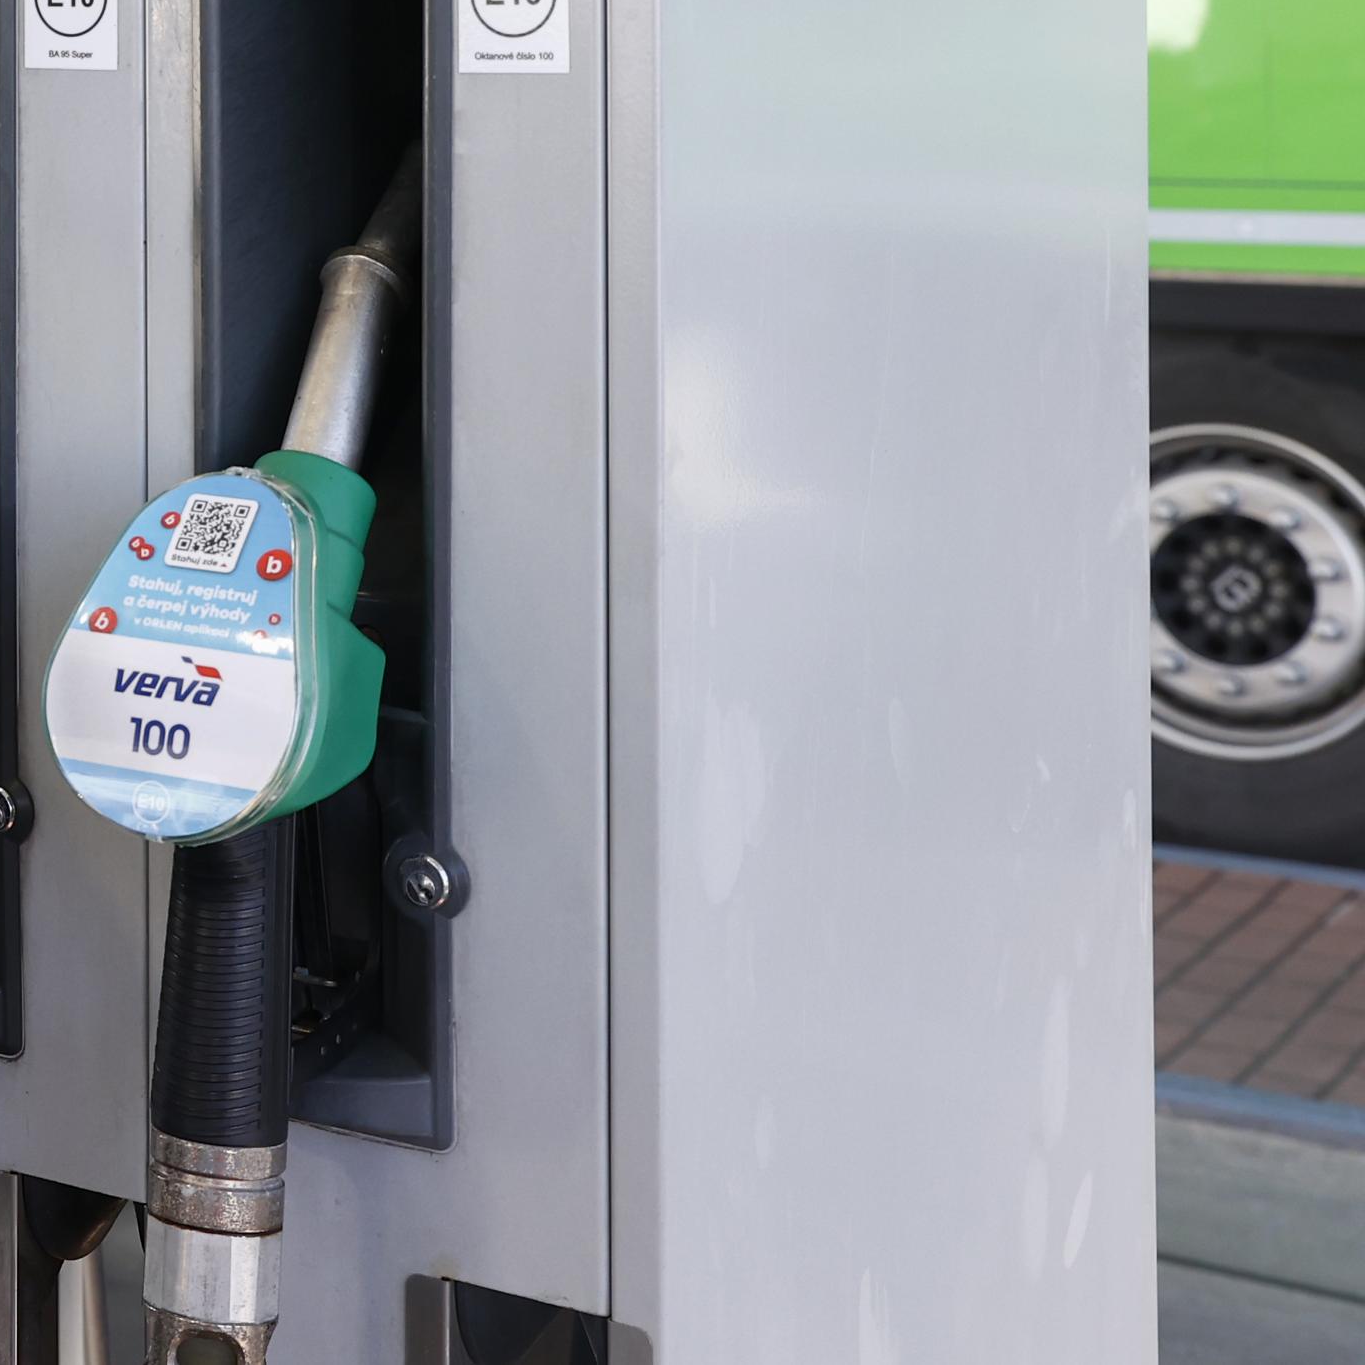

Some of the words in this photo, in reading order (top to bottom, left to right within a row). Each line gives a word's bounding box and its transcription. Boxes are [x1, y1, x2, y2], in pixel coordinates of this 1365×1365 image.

[72, 51, 93, 60] Super
[475, 52, 514, 60] Oktanové
[517, 52, 535, 60] číslo
[171, 554, 200, 565] Stahuj
[202, 558, 218, 566] zde
[128, 574, 183, 595] Stahuj,
[187, 585, 258, 606] registruj
[124, 596, 134, 606] a
[137, 594, 187, 615] čerpej
[190, 604, 251, 624] výhody
[143, 618, 183, 631] ORLEN
[114, 668, 221, 706] verva
[131, 717, 191, 760] 100
